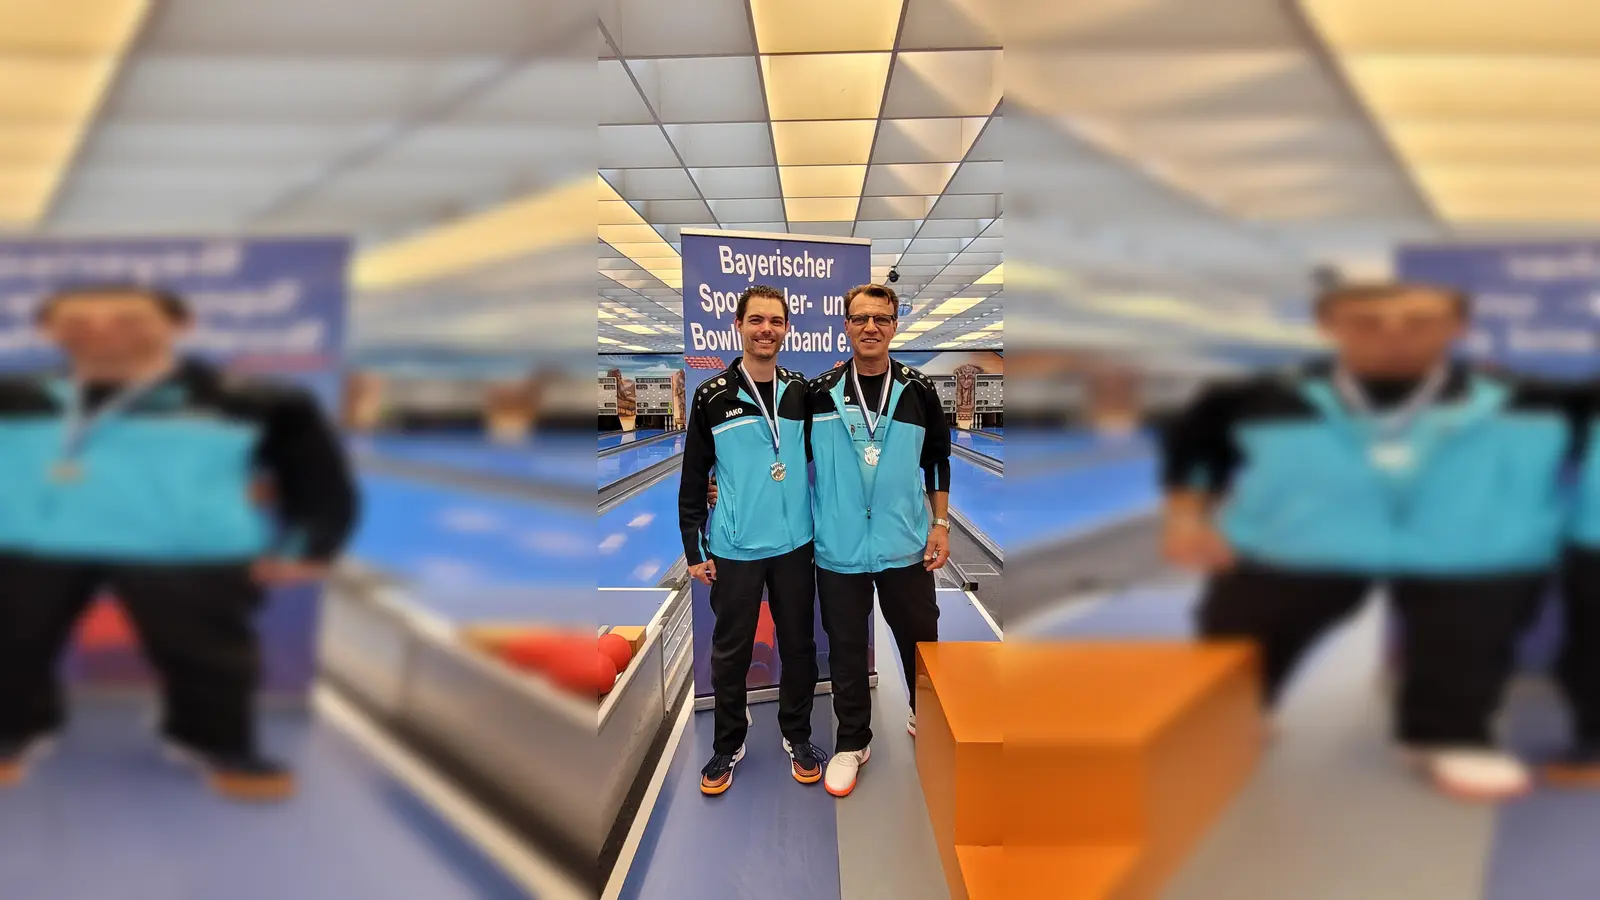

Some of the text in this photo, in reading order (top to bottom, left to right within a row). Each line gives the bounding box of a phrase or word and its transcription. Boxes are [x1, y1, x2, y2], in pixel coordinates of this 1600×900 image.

[718, 245, 835, 282] Bayerischer
[823, 295, 845, 316] un
[725, 407, 743, 418] JAKO
